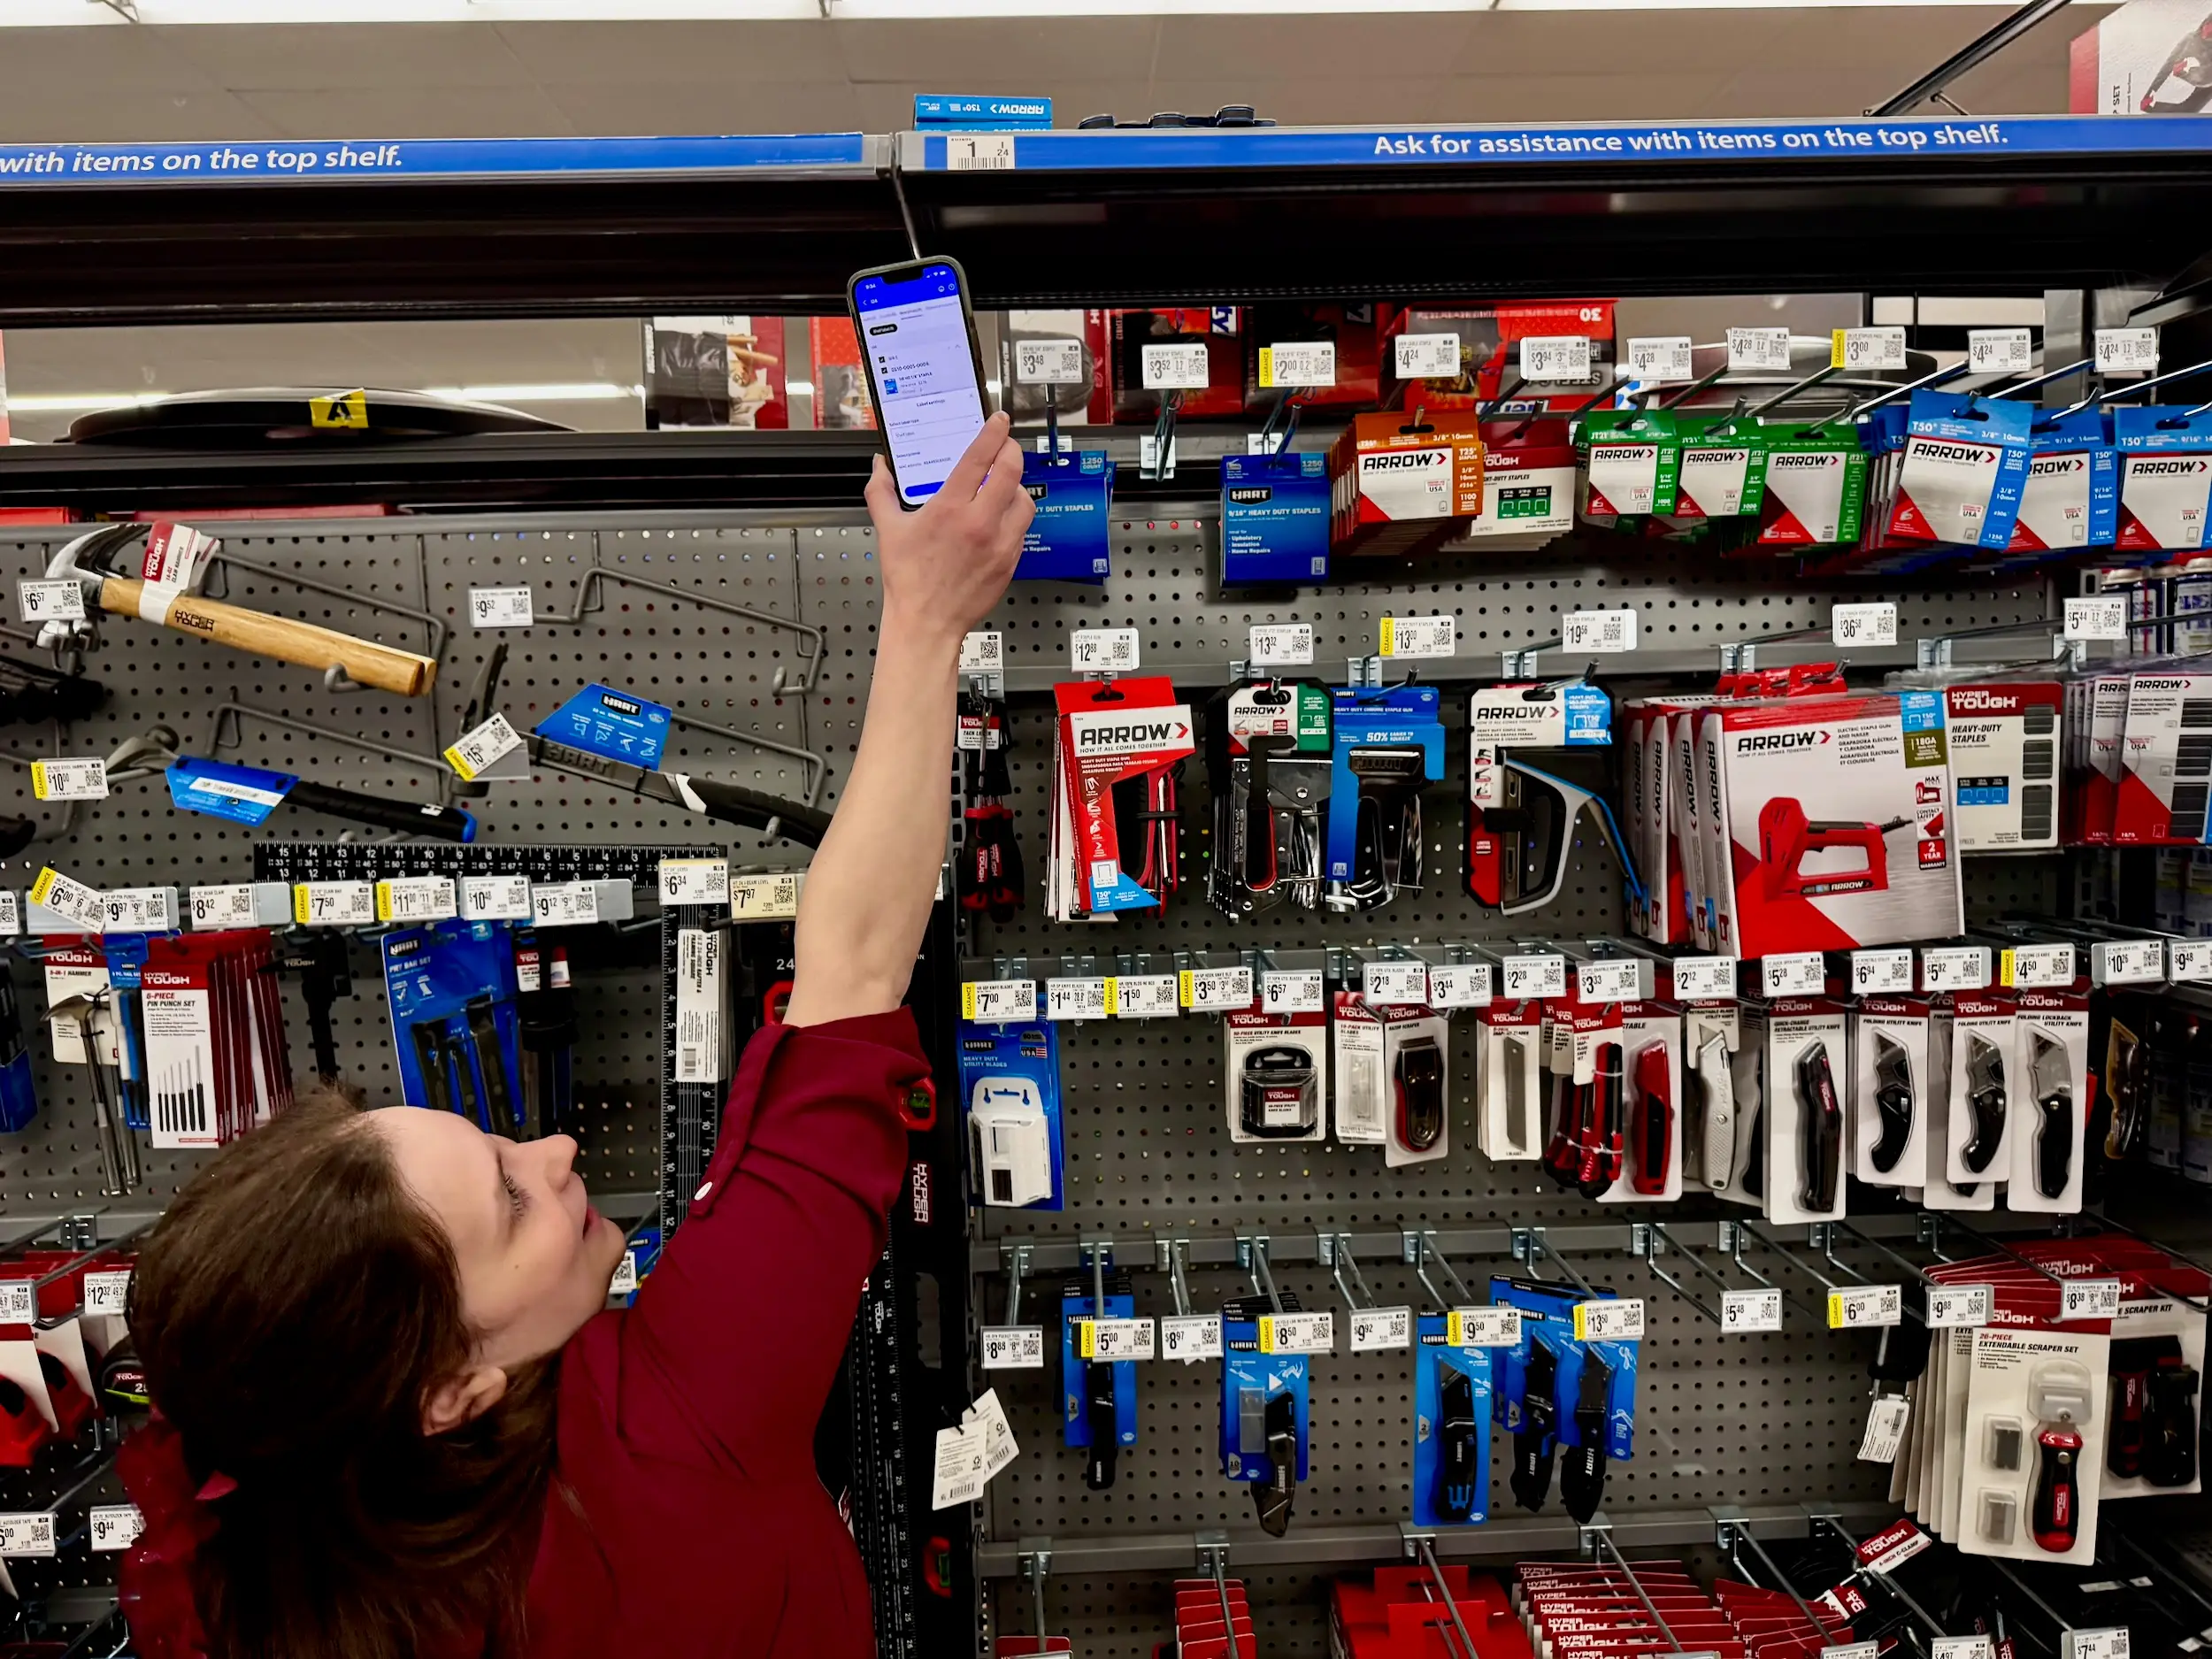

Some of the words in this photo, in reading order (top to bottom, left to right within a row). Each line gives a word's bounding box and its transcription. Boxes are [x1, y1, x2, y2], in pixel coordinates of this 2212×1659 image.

[1374, 135, 1426, 155] Ask
[1431, 133, 1471, 153] for
[1479, 133, 1623, 153] assistance
[1627, 131, 1692, 150] with
[1698, 128, 1775, 150] items
[1783, 130, 1820, 148] on
[1824, 127, 1872, 147] the
[1878, 127, 1927, 150] top
[1933, 123, 2008, 145] shelf.
[73, 150, 155, 173] items
[163, 150, 200, 171] on
[209, 147, 258, 171] the
[266, 147, 317, 174] top
[324, 143, 403, 168] shelf.
[1594, 449, 1645, 459] ARROW
[1686, 452, 1737, 463] ARROW
[1913, 443, 1983, 462] ARROW
[1302, 459, 1323, 468] 1250
[1363, 454, 1433, 470] ARROW
[1776, 456, 1828, 466] ARROW
[2132, 461, 2196, 474] ARROW
[1232, 490, 1267, 500] HART
[1962, 510, 1978, 518] USA
[2134, 680, 2182, 689] ARROW
[603, 695, 640, 714] HART
[1952, 695, 2016, 710] TOUGH
[1234, 706, 1277, 716] ARROW
[1477, 706, 1545, 719] ARROW
[1952, 724, 2001, 733] HEAVY-DUTY
[1080, 723, 1171, 746] ARROW
[1367, 732, 1388, 742] 50%
[1952, 734, 1986, 743] STAPLES
[1738, 731, 1816, 751] ARROW
[1915, 736, 1937, 745] 18GA
[35, 766, 45, 796] CLEARANCE
[1682, 739, 1697, 818] ARROW
[1707, 740, 1720, 821] ARROW
[1928, 842, 1935, 852] 2
[35, 872, 51, 901] CLEARANCE
[1831, 881, 1863, 891] ARROW
[50, 952, 92, 964] TOUGH
[419, 956, 431, 965] SET
[777, 958, 795, 971] 24
[146, 975, 189, 985] TOUGH
[1774, 1002, 1812, 1011] TOUGH
[1865, 1002, 1906, 1012] TOUGH
[2019, 997, 2063, 1007] TOUGH
[1388, 1008, 1418, 1018] TOUGH
[1959, 1004, 1996, 1013] TOUGH
[1233, 1016, 1268, 1025] TOUGH
[1575, 1018, 1602, 1029] TOUGH
[913, 1164, 923, 1222] TOUGH
[920, 1164, 929, 1223] HYPER
[2124, 1304, 2158, 1315] SCRAPER
[1979, 1340, 2025, 1350] EXTENDABLE
[2027, 1343, 2063, 1352] SCRAPER
[1863, 1527, 1908, 1556] TOUGH
[1541, 1603, 1574, 1612] HYPER
